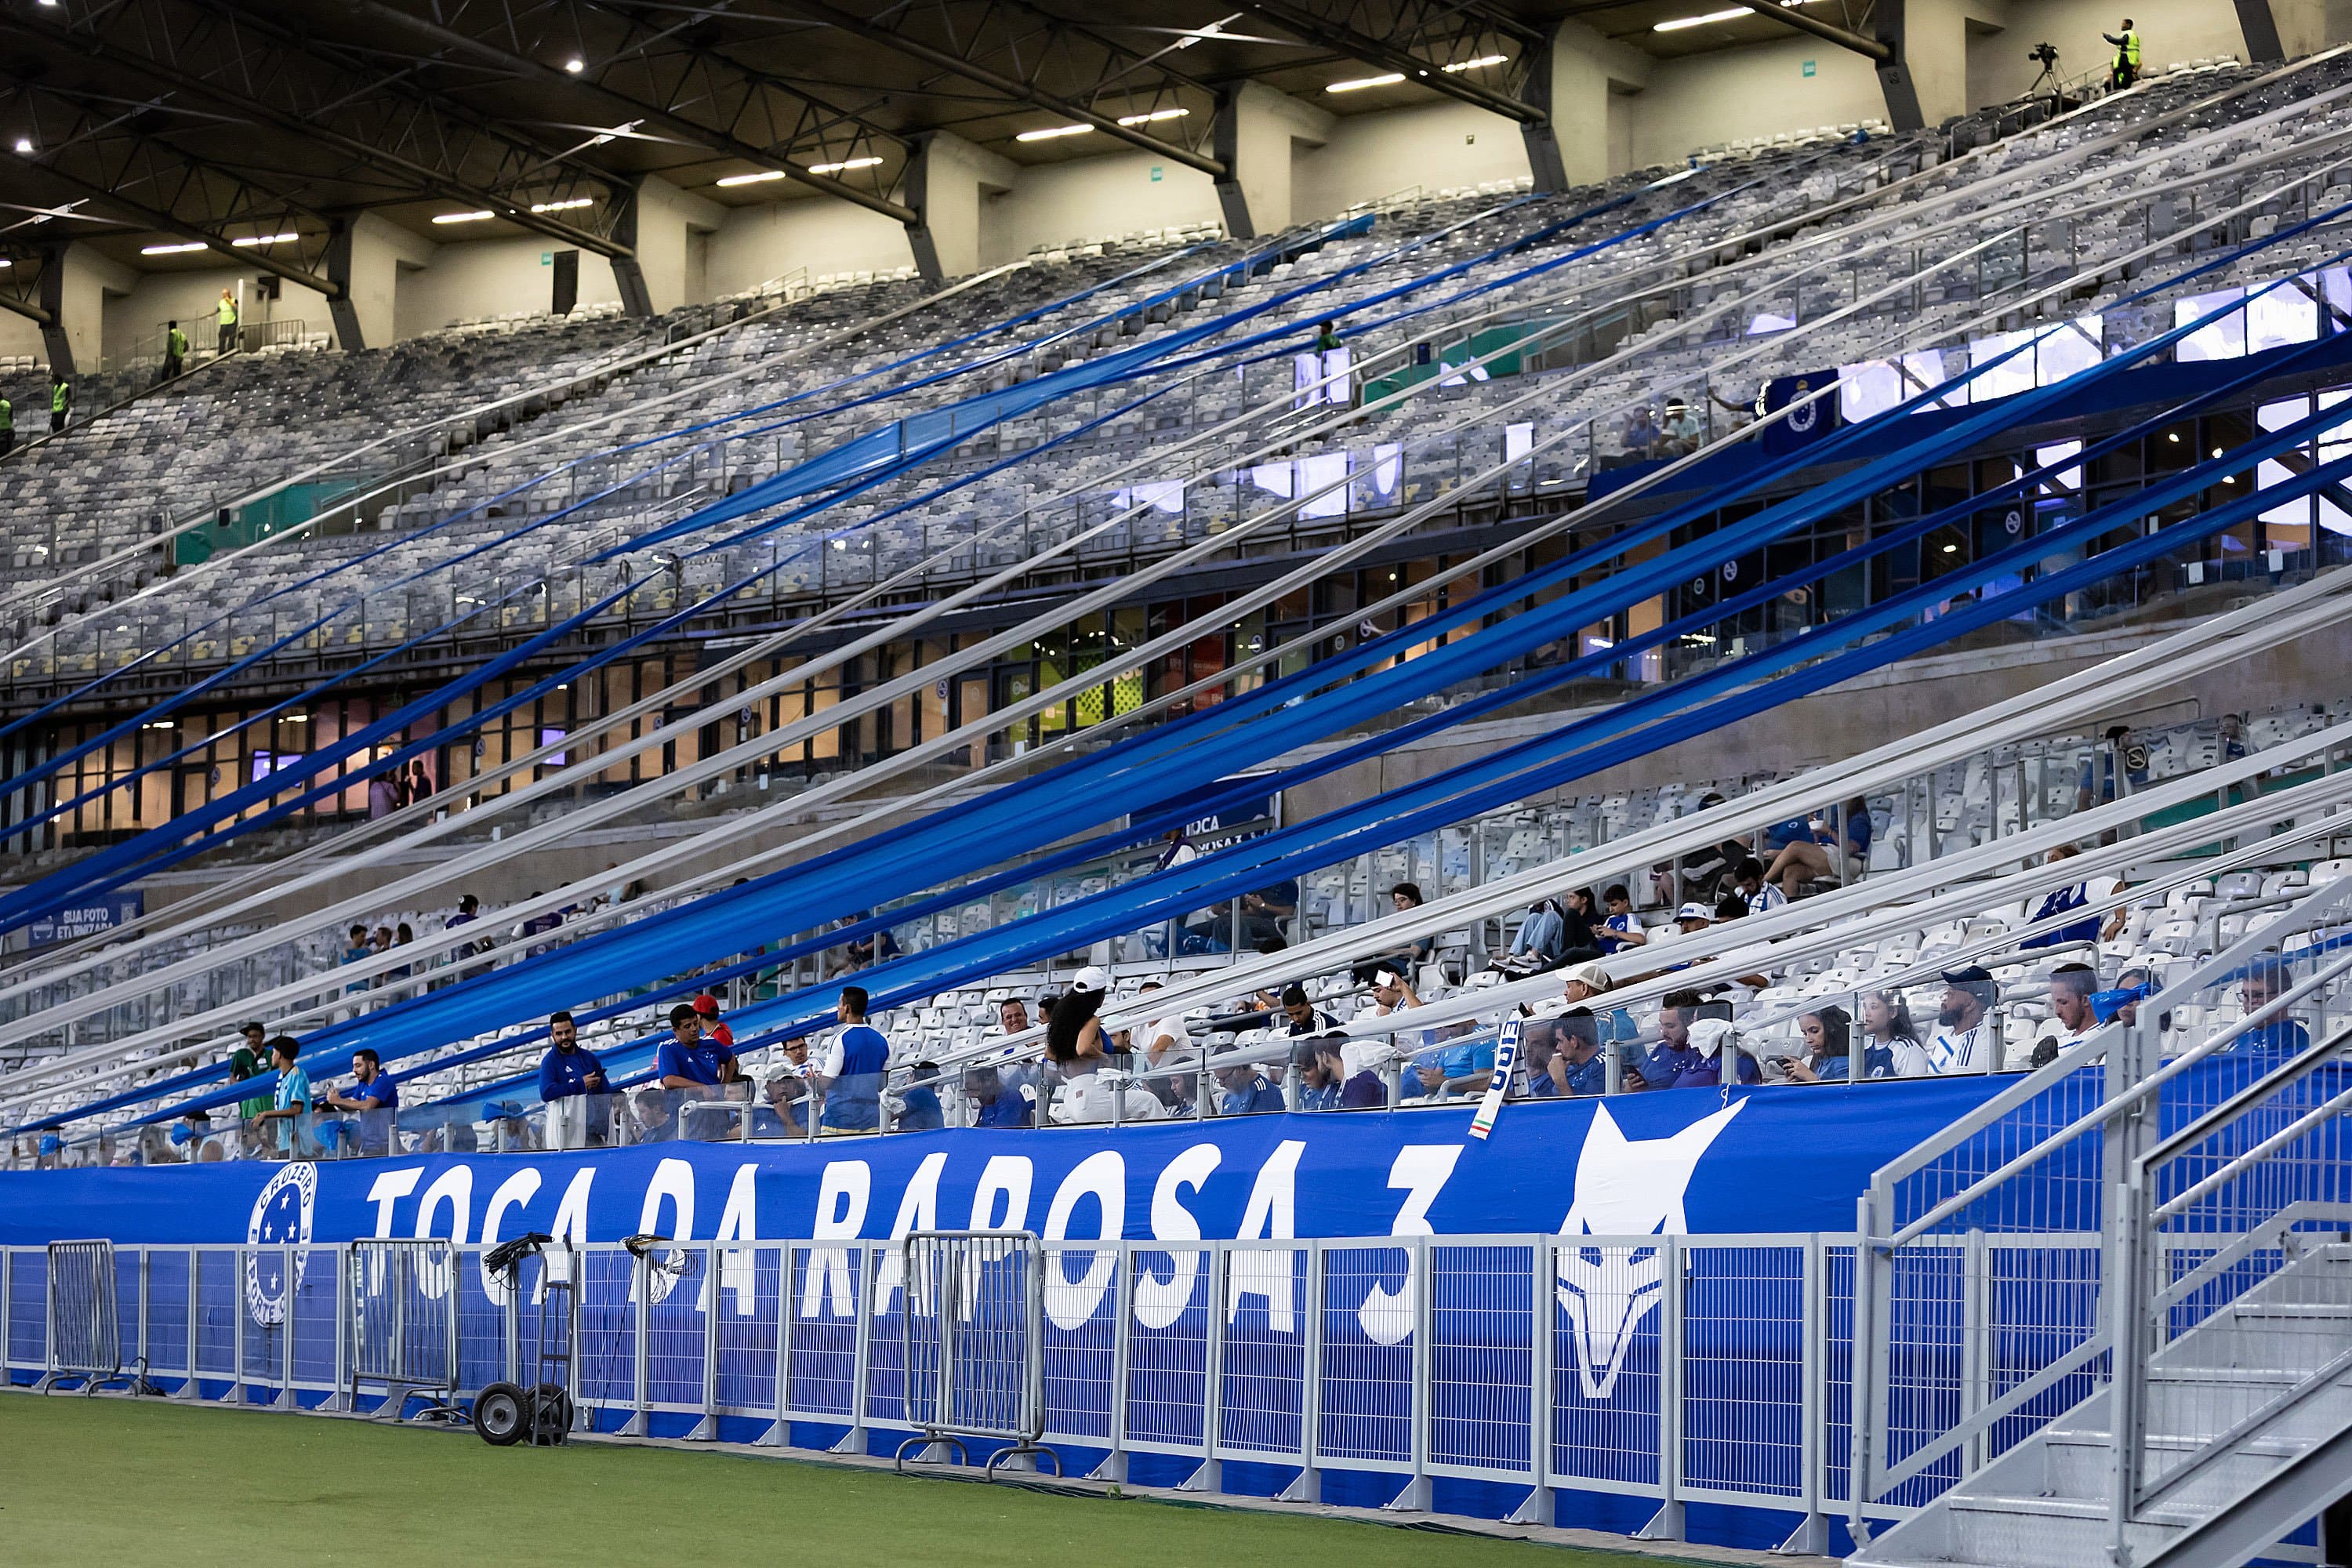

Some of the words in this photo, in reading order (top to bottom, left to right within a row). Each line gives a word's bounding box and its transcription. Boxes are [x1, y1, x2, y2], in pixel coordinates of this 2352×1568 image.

[64, 909, 82, 924] SUA
[83, 907, 109, 923] FOTO
[260, 1164, 313, 1210] CRUZEIRO
[365, 1165, 597, 1306] TOCA
[630, 1158, 759, 1316] DA
[801, 1140, 1307, 1333] RAPOSA
[1358, 1144, 1465, 1345] 3
